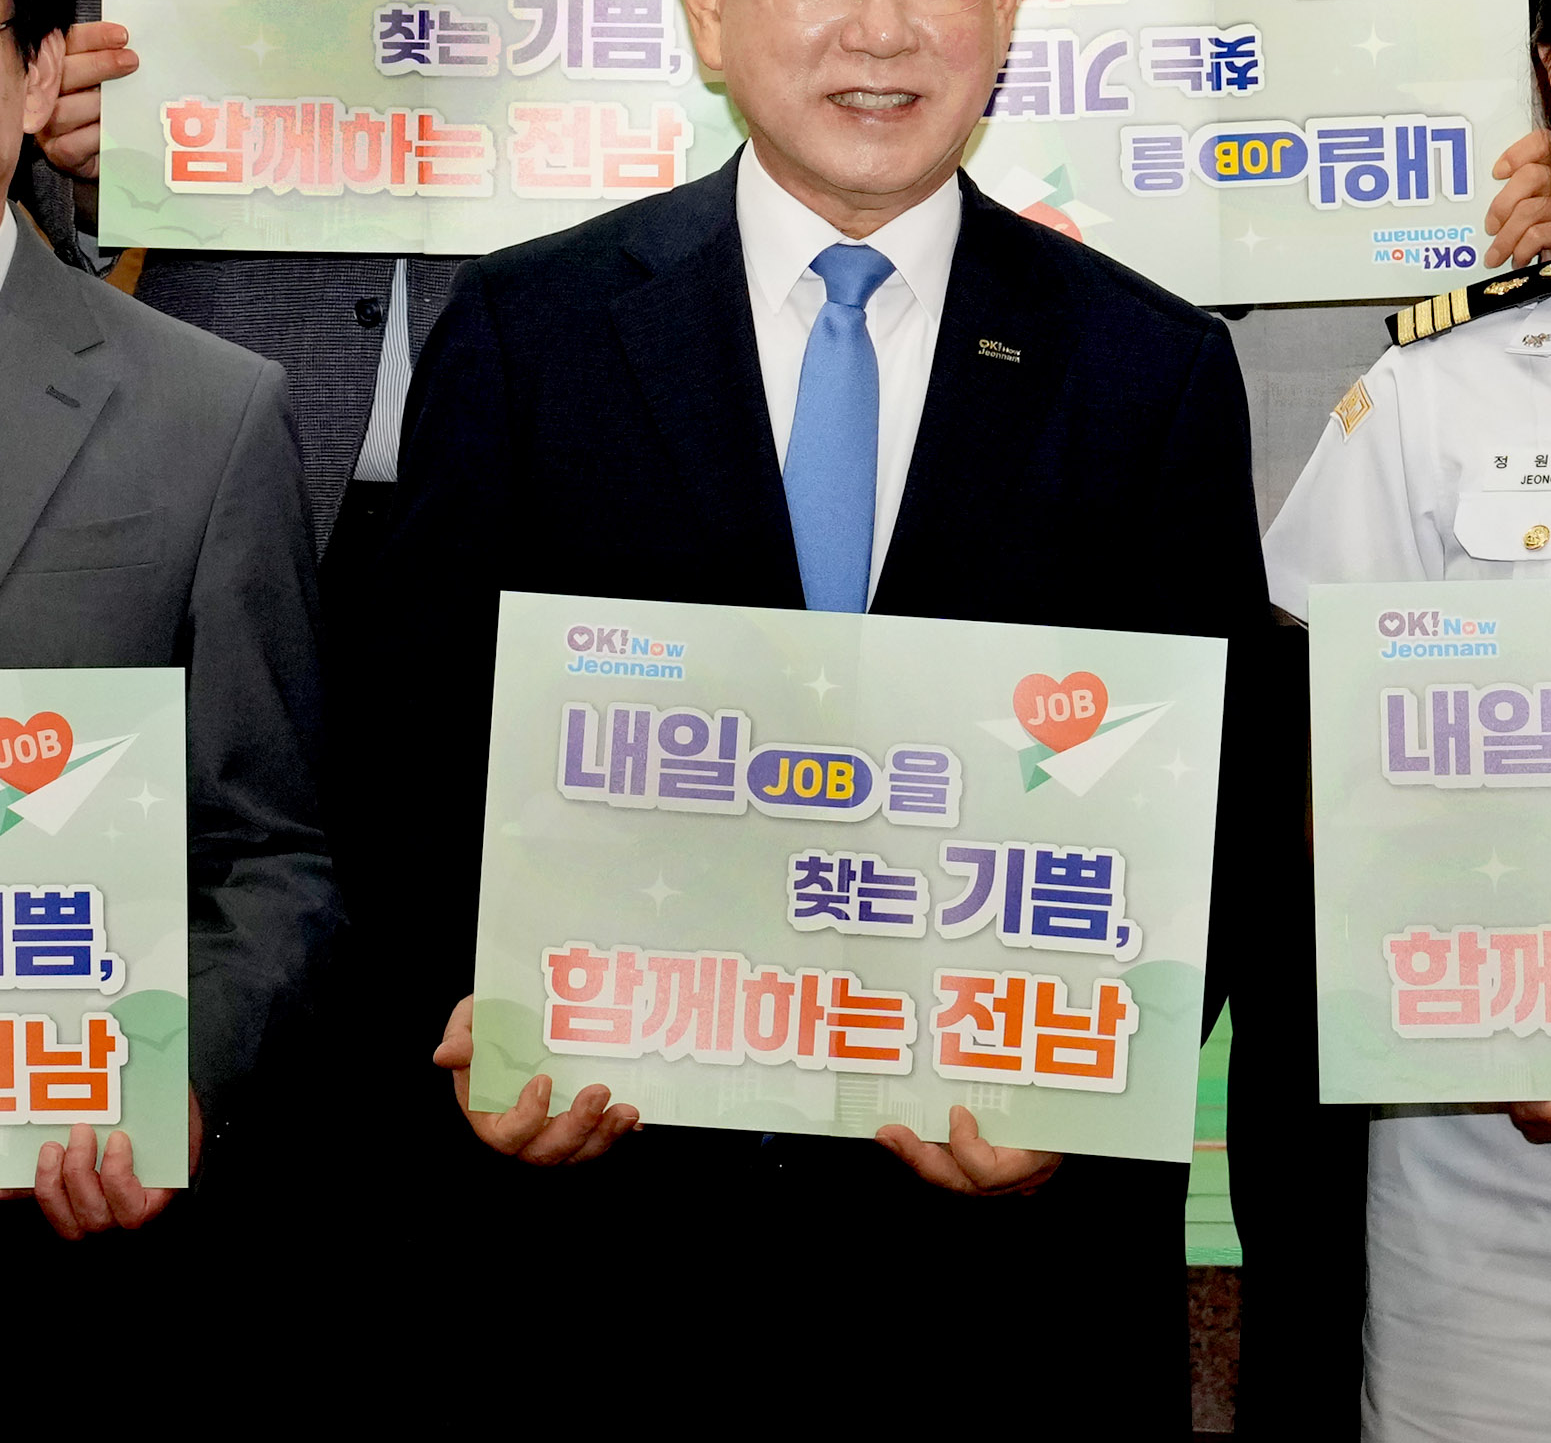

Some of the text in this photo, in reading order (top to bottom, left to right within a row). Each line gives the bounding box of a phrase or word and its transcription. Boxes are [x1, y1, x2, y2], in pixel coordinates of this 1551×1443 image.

[379, 9, 491, 64] 찾는
[1152, 35, 1259, 92] 찾는
[166, 101, 682, 189] 함께하는 전남
[1131, 126, 1468, 205] 내일 JOB 을
[1373, 228, 1473, 244] Jeonnam
[1374, 245, 1477, 268] OK! Now
[567, 625, 685, 658] OK! Now
[1379, 612, 1496, 638] OK! Now
[567, 655, 684, 680] Jeonnam
[1380, 640, 1497, 658] Jeonnam
[1027, 689, 1096, 725] JOB
[564, 708, 950, 815] 내일 JOB 을
[793, 847, 1130, 949] 찾는 기쁨,
[547, 948, 1128, 1080] 함께하는 전남
